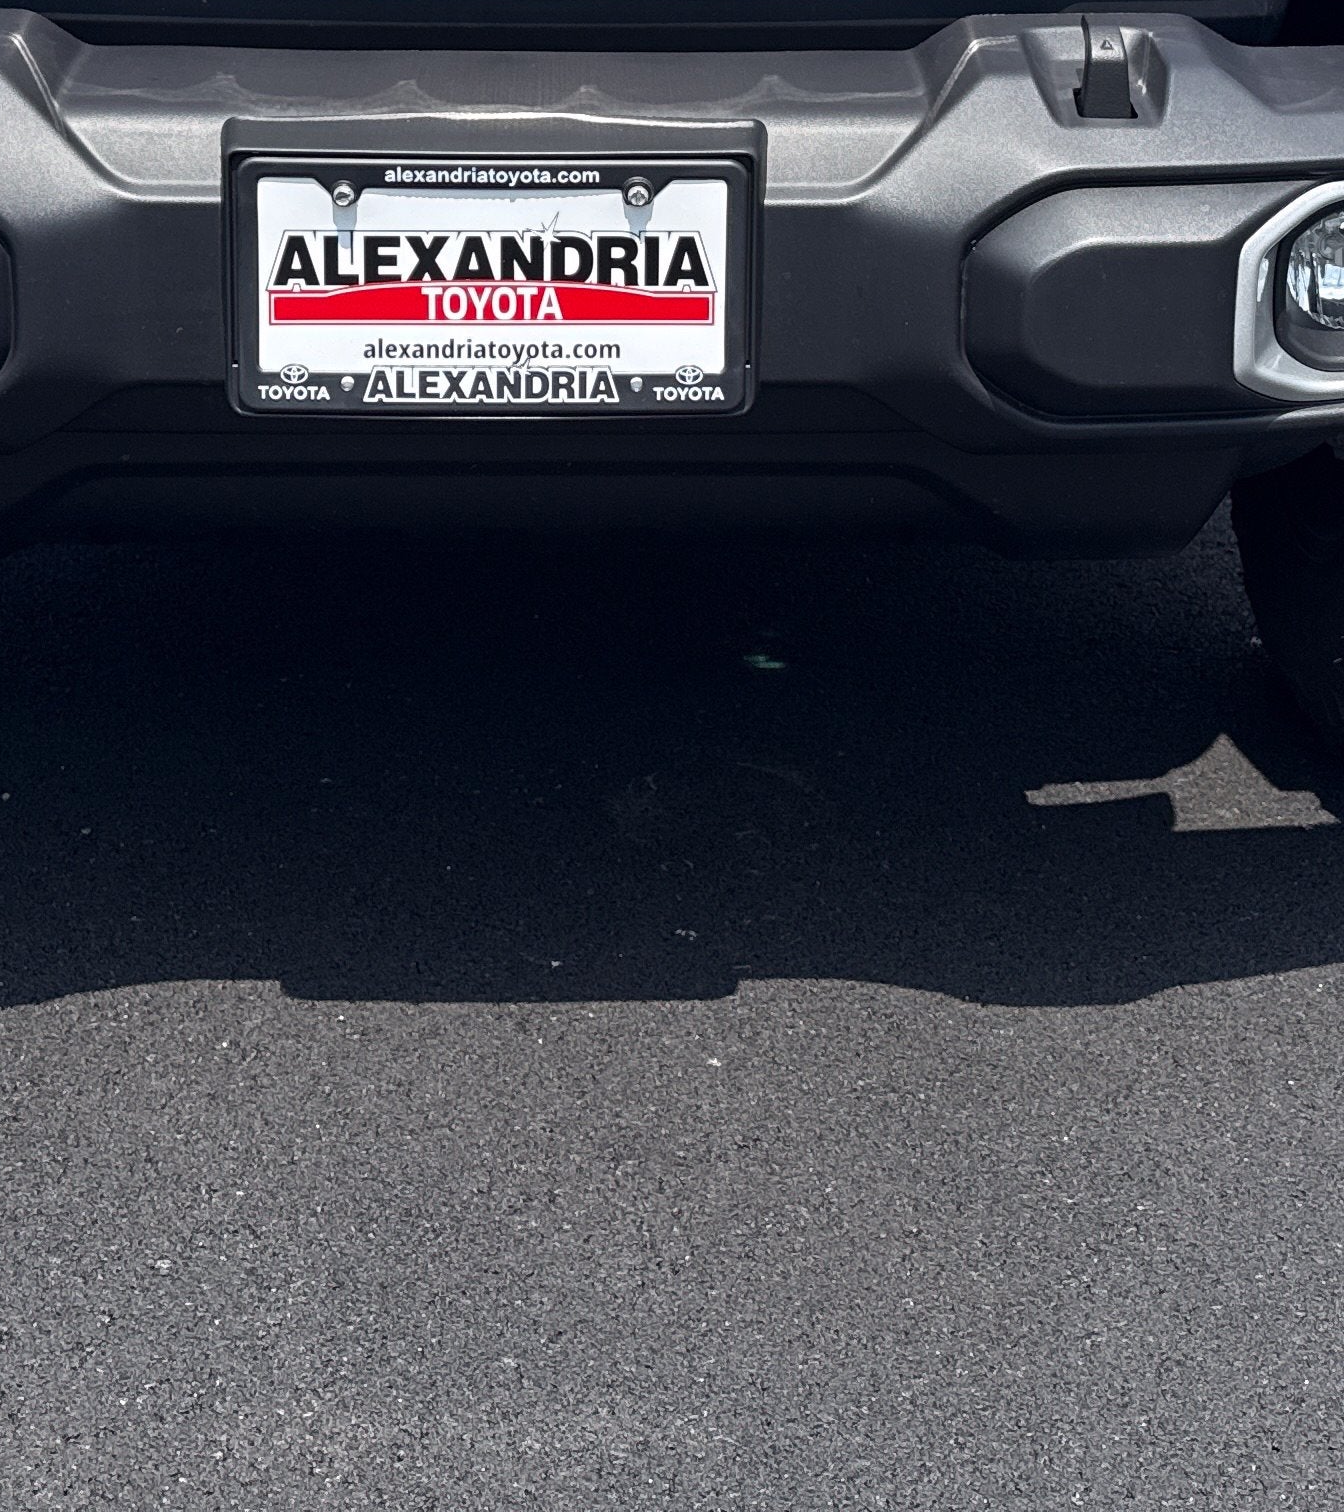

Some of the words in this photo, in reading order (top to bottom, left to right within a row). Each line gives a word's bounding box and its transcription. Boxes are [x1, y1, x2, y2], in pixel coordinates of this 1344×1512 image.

[384, 166, 600, 187] alexandriatoyota.com
[271, 234, 713, 288] ALEXANDRIA
[420, 286, 564, 321] TOYOTA
[362, 338, 622, 366] alexandriatoyota.com
[257, 385, 331, 401] TOYOTA
[364, 368, 618, 402] ALEXANDRIA
[653, 386, 725, 402] TOYOTA
